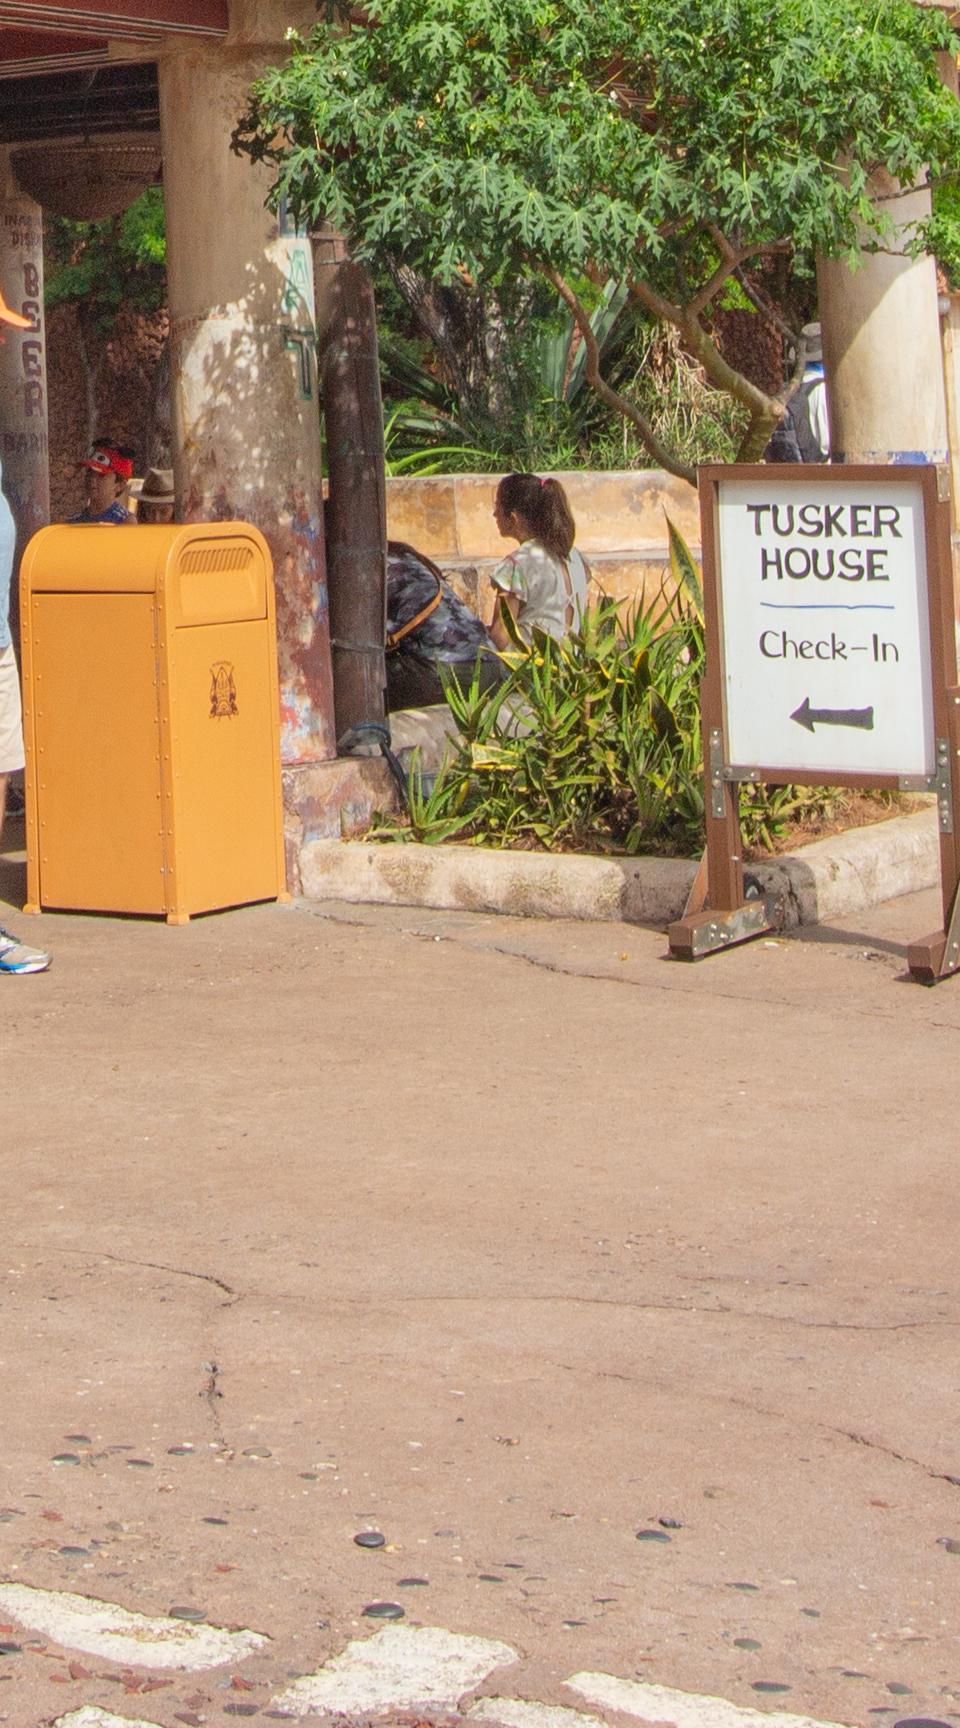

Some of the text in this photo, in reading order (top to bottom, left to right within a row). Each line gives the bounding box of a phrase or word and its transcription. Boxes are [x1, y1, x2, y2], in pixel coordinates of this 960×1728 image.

[746, 503, 902, 538] TUSKER
[761, 547, 890, 581] HOUSE
[759, 630, 900, 663] Check-In
